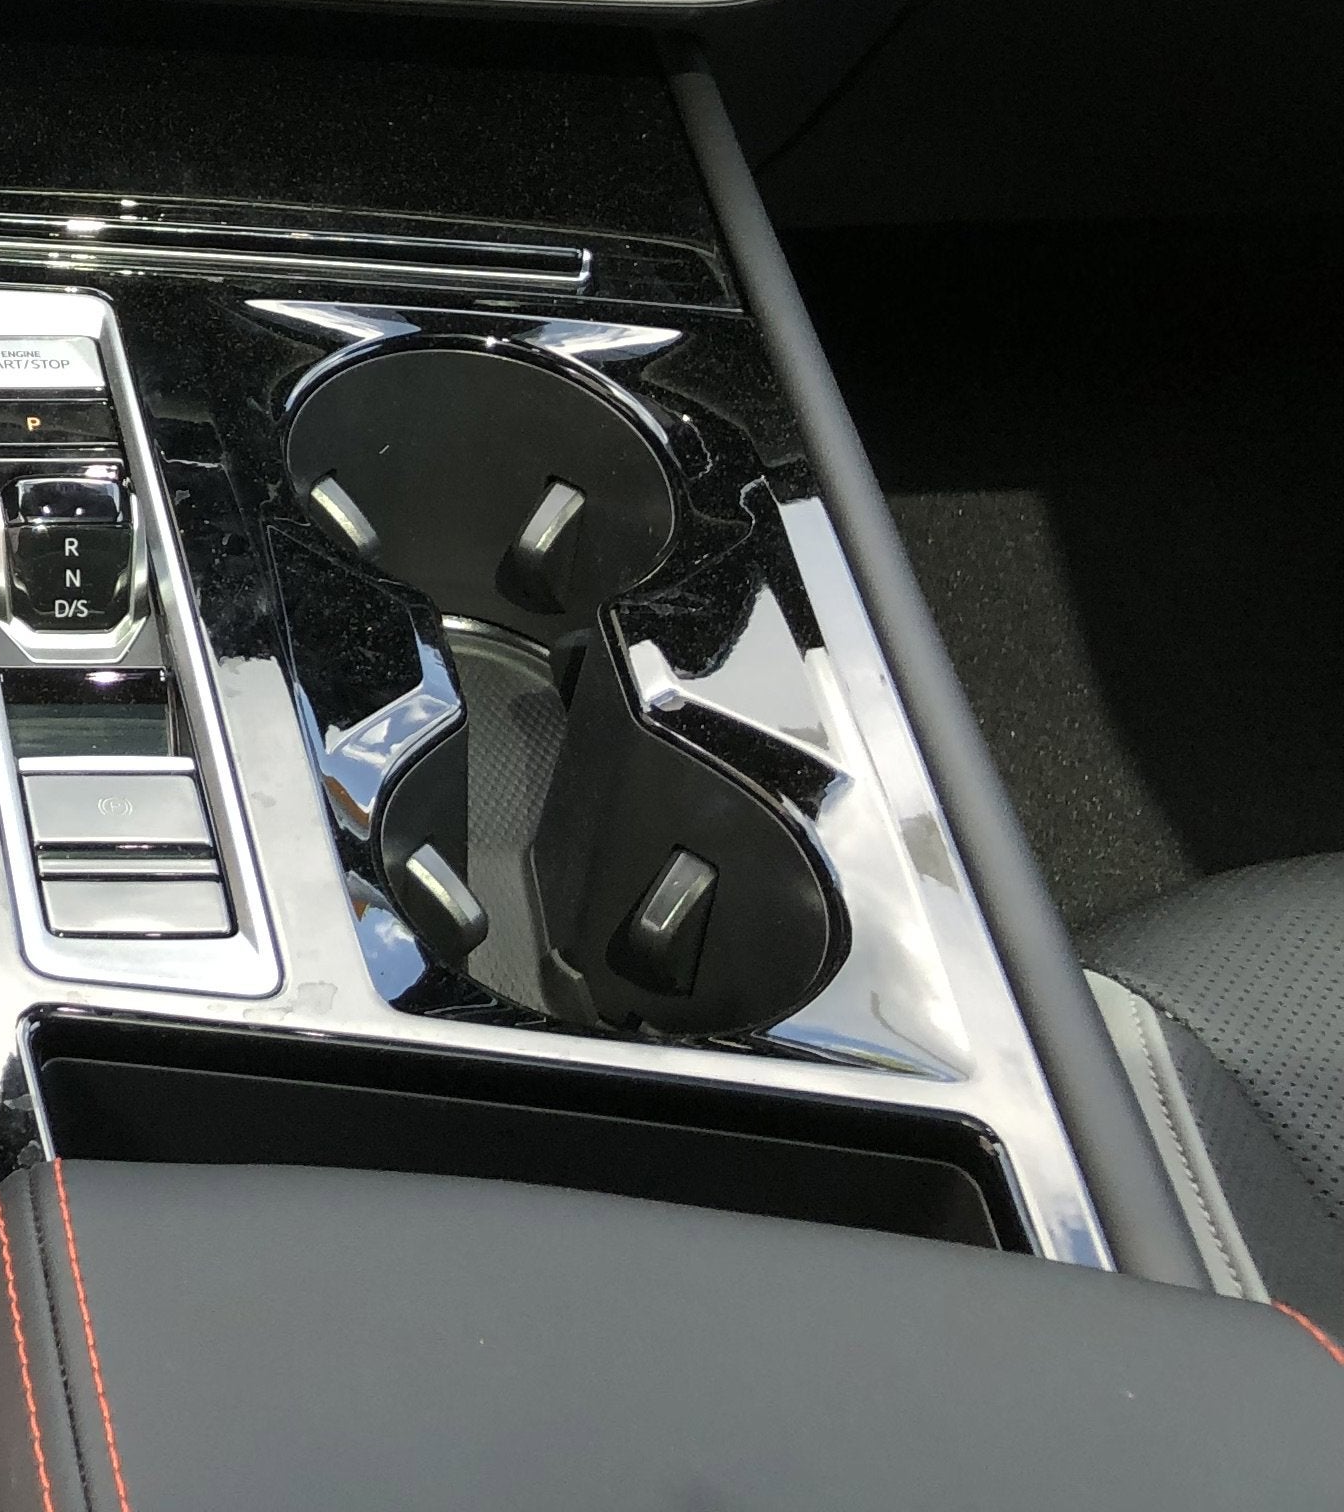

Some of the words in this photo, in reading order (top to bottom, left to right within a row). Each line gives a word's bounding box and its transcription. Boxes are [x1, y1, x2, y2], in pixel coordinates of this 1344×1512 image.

[0, 350, 41, 358] ENGINE
[26, 416, 41, 431] P
[64, 537, 79, 556] R
[65, 569, 81, 587] N
[54, 599, 89, 618] D/S
